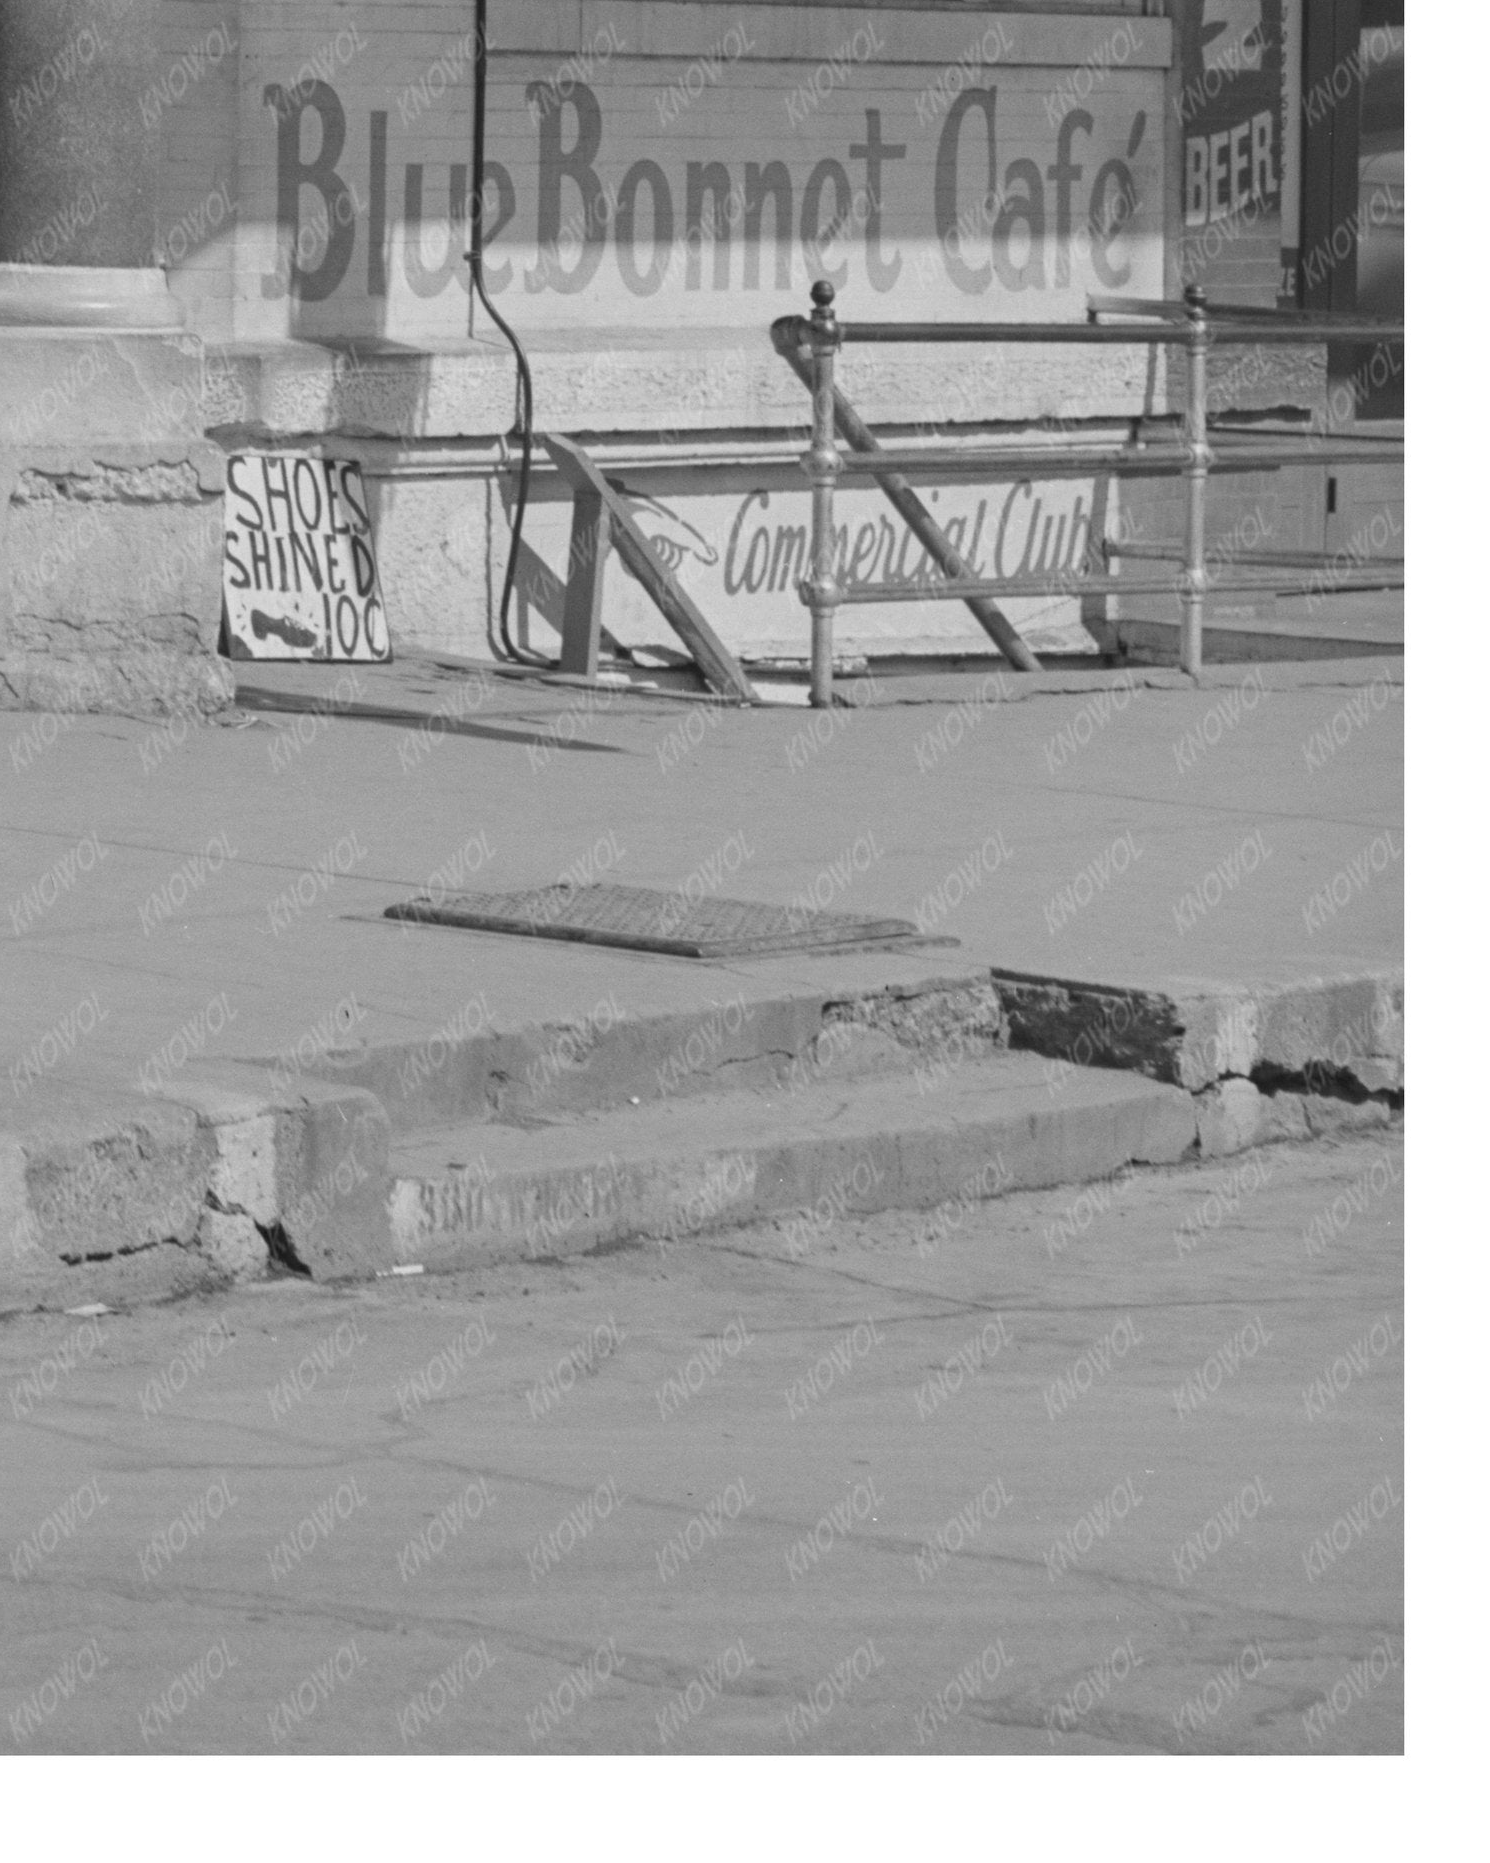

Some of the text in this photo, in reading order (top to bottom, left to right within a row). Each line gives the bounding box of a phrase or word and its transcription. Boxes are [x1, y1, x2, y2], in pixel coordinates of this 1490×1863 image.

[933, 83, 1149, 297] Café
[1185, 110, 1278, 226] BEER
[226, 455, 371, 535] SHOES
[225, 530, 376, 598] SHINED
